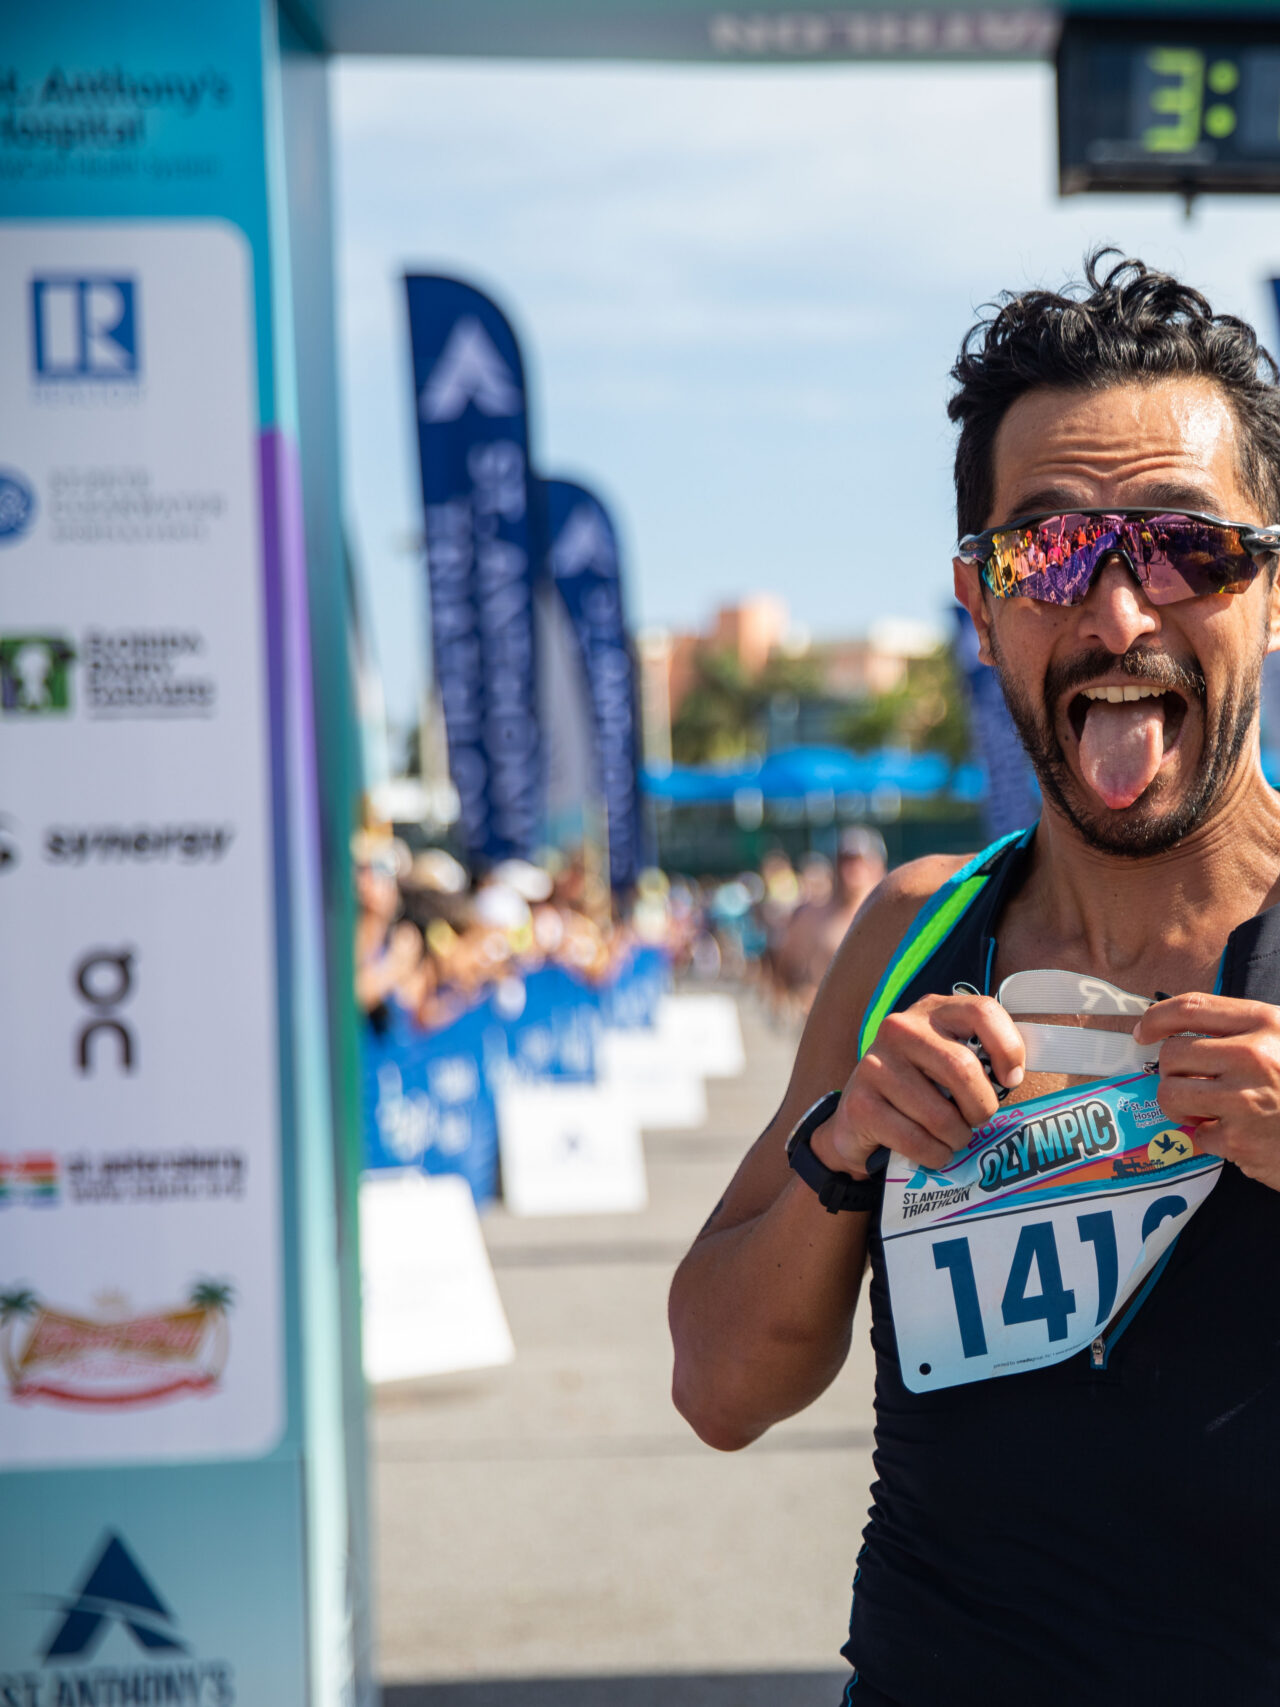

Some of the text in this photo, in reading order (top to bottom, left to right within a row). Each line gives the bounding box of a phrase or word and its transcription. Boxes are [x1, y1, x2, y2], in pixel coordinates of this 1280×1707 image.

[978, 1100, 1115, 1191] OLYMPIC
[903, 1193, 919, 1205] ST.
[903, 1188, 970, 1219] TRIATHLON
